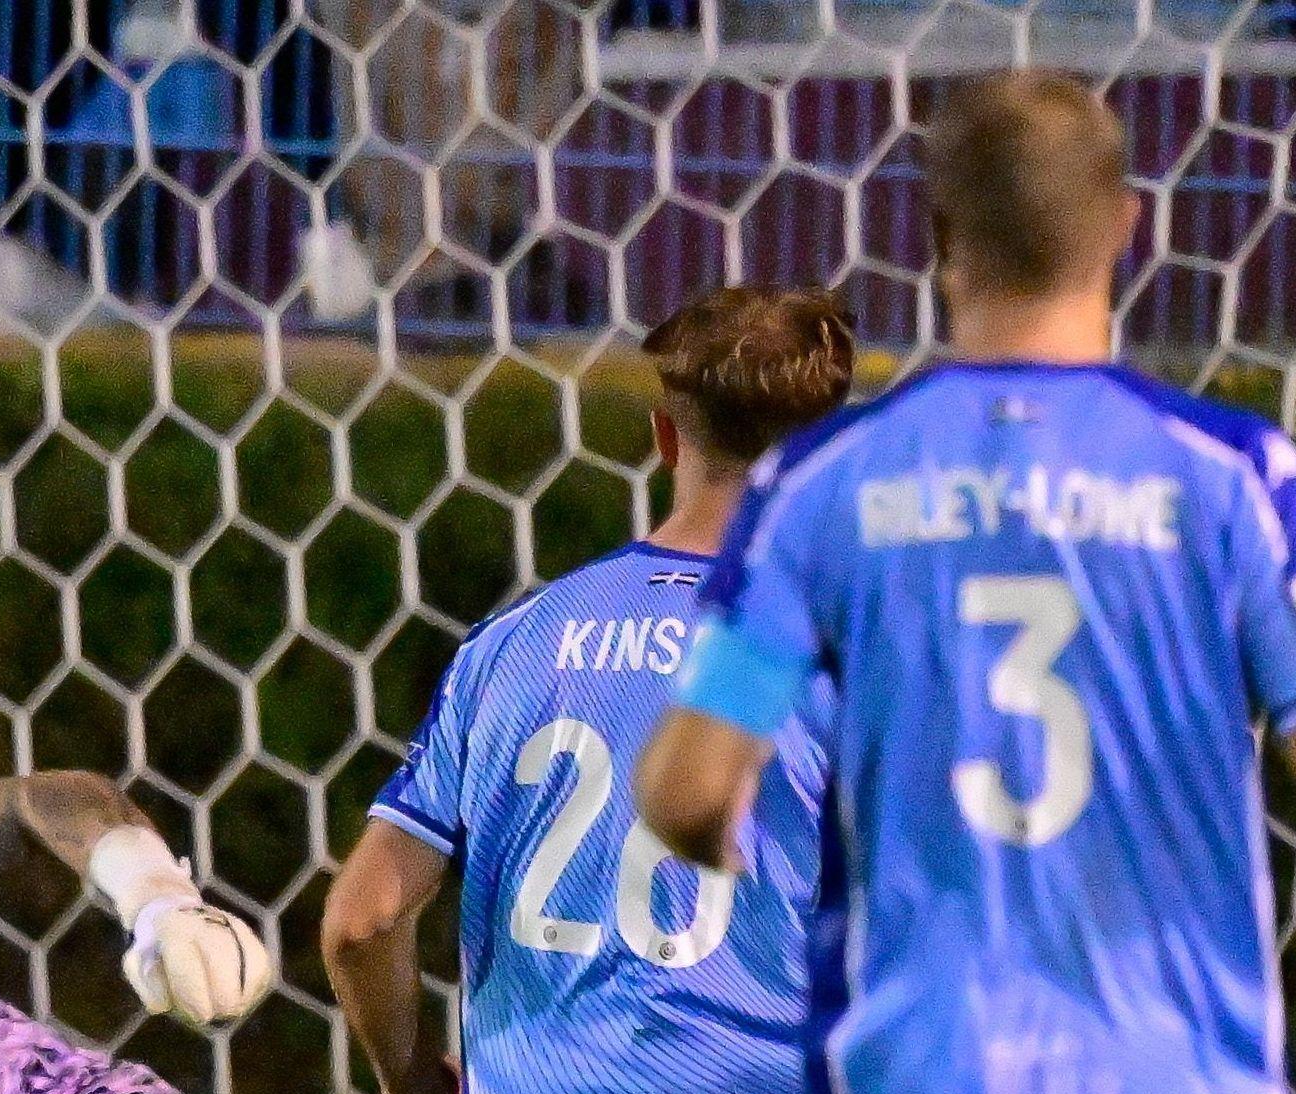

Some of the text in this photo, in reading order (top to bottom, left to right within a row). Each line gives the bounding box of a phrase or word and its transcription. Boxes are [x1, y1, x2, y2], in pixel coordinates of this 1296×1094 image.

[556, 616, 688, 675] KINS
[952, 572, 1093, 846] 3
[510, 718, 735, 969] 26
